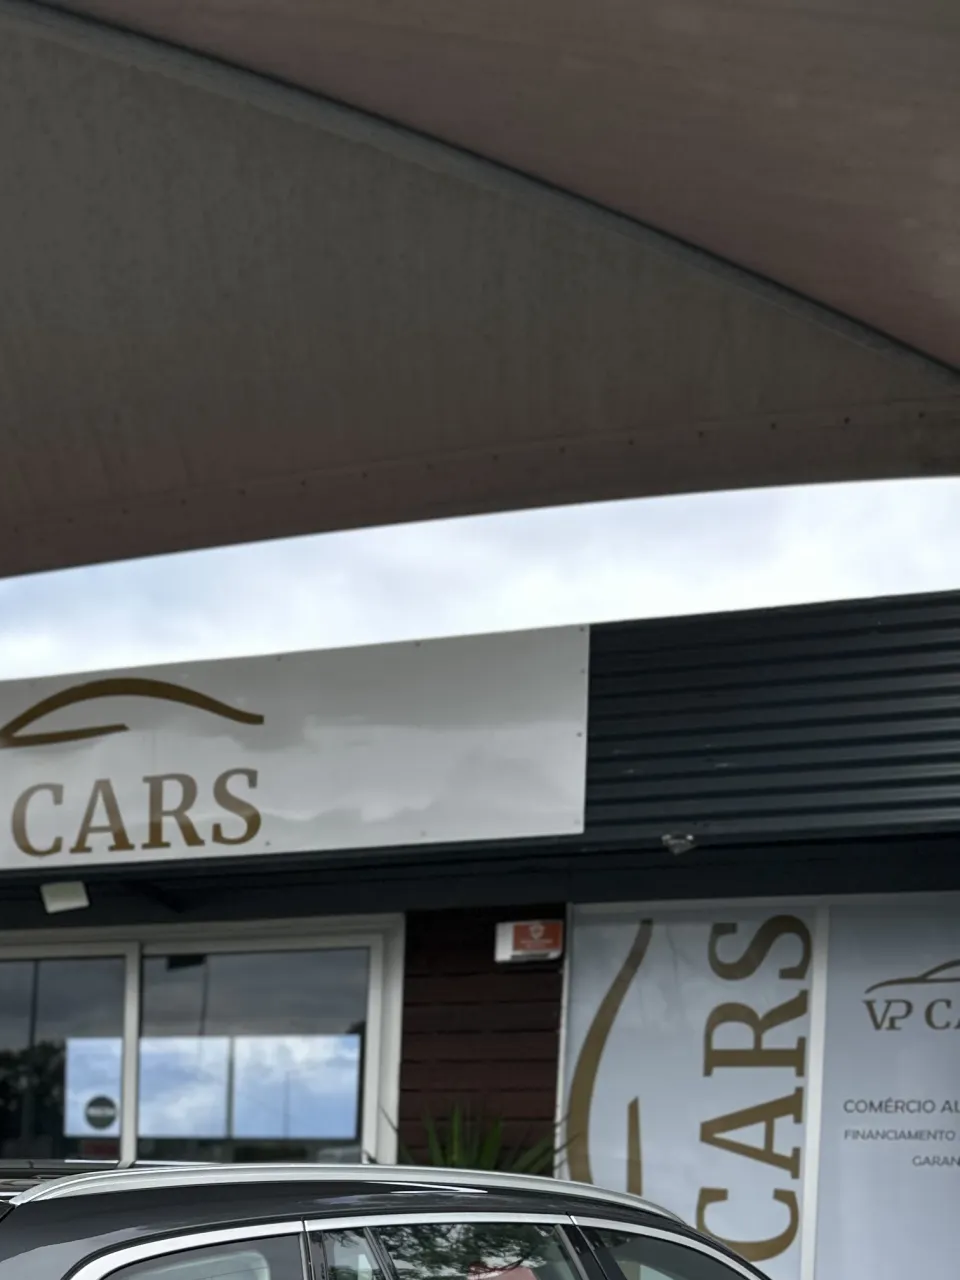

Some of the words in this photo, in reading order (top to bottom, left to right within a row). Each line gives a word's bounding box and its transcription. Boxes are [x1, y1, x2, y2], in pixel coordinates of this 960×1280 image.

[10, 768, 262, 857] CARS
[861, 998, 913, 1031] VP
[924, 998, 960, 1031] C
[695, 914, 813, 1263] CARS
[843, 1097, 936, 1114] COMÉRCIO
[844, 1129, 956, 1141] FINANCIAMENTO
